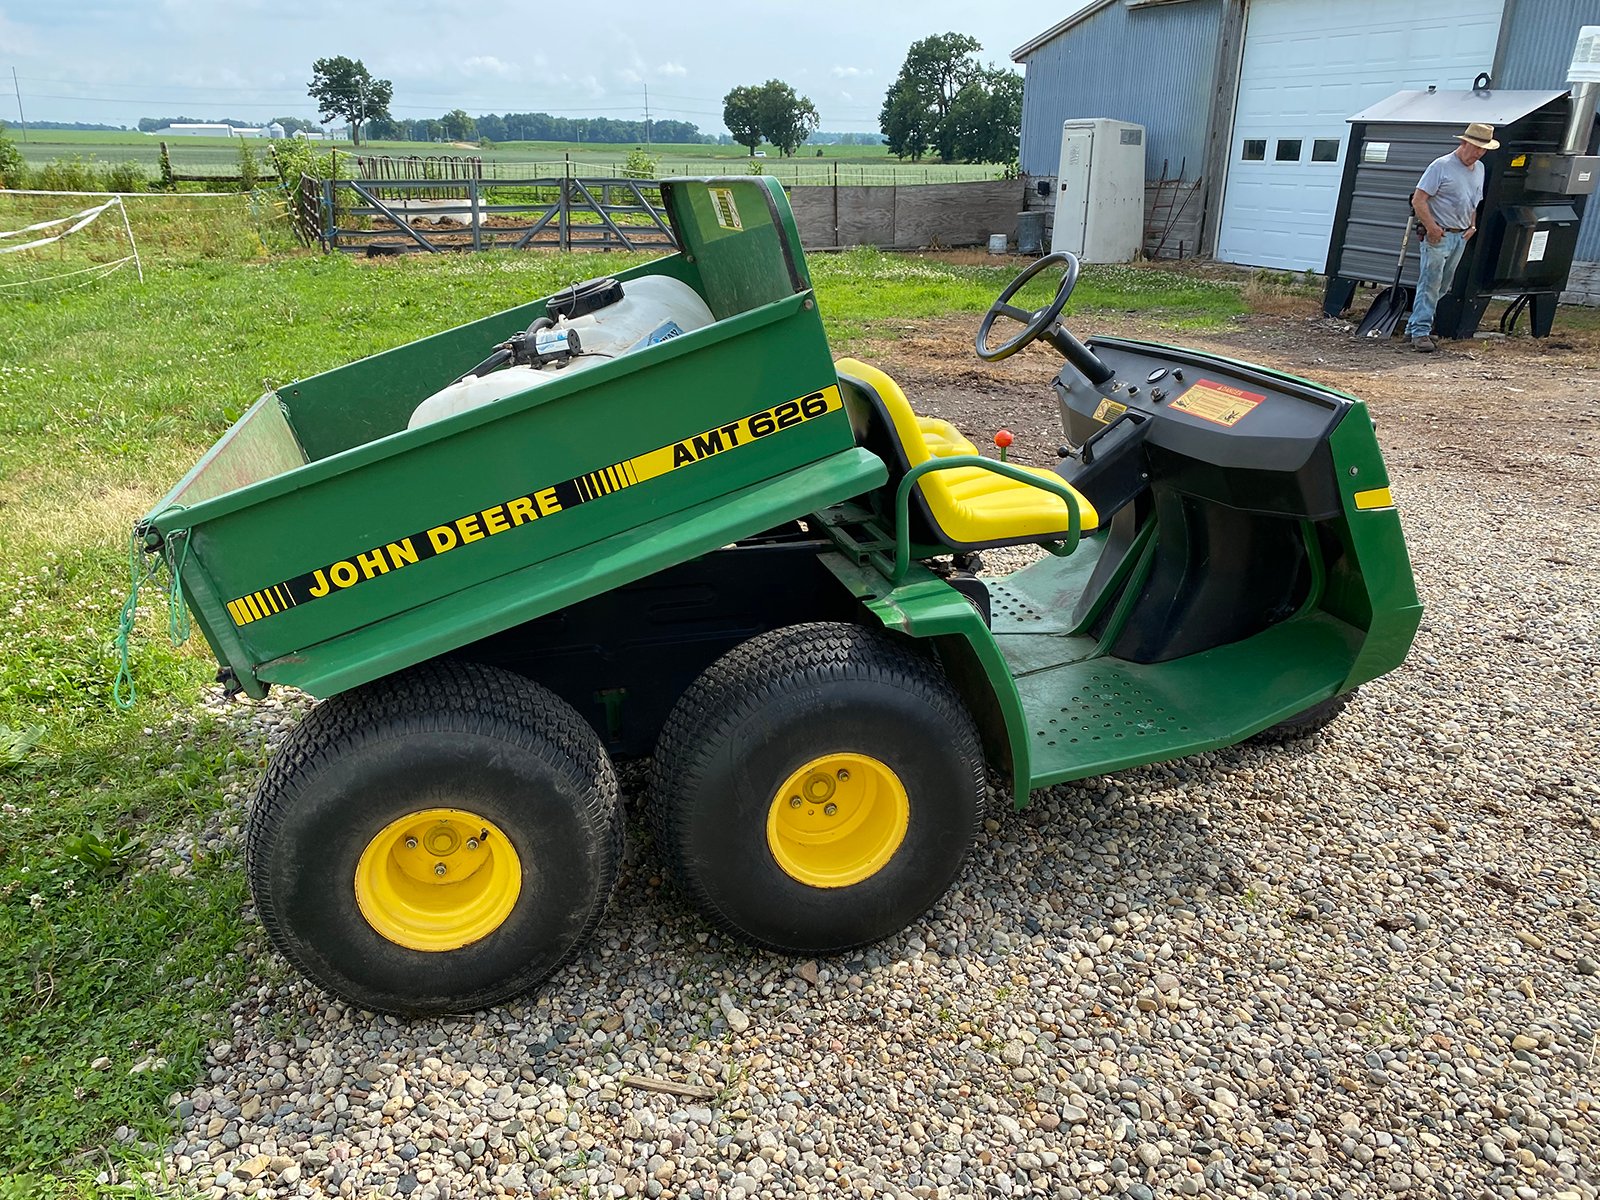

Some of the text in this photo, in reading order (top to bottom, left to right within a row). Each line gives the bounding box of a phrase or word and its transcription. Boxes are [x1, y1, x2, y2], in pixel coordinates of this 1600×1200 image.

[1221, 386, 1243, 396] DANGER
[309, 392, 828, 597] JOHN DEERE AMT 626
